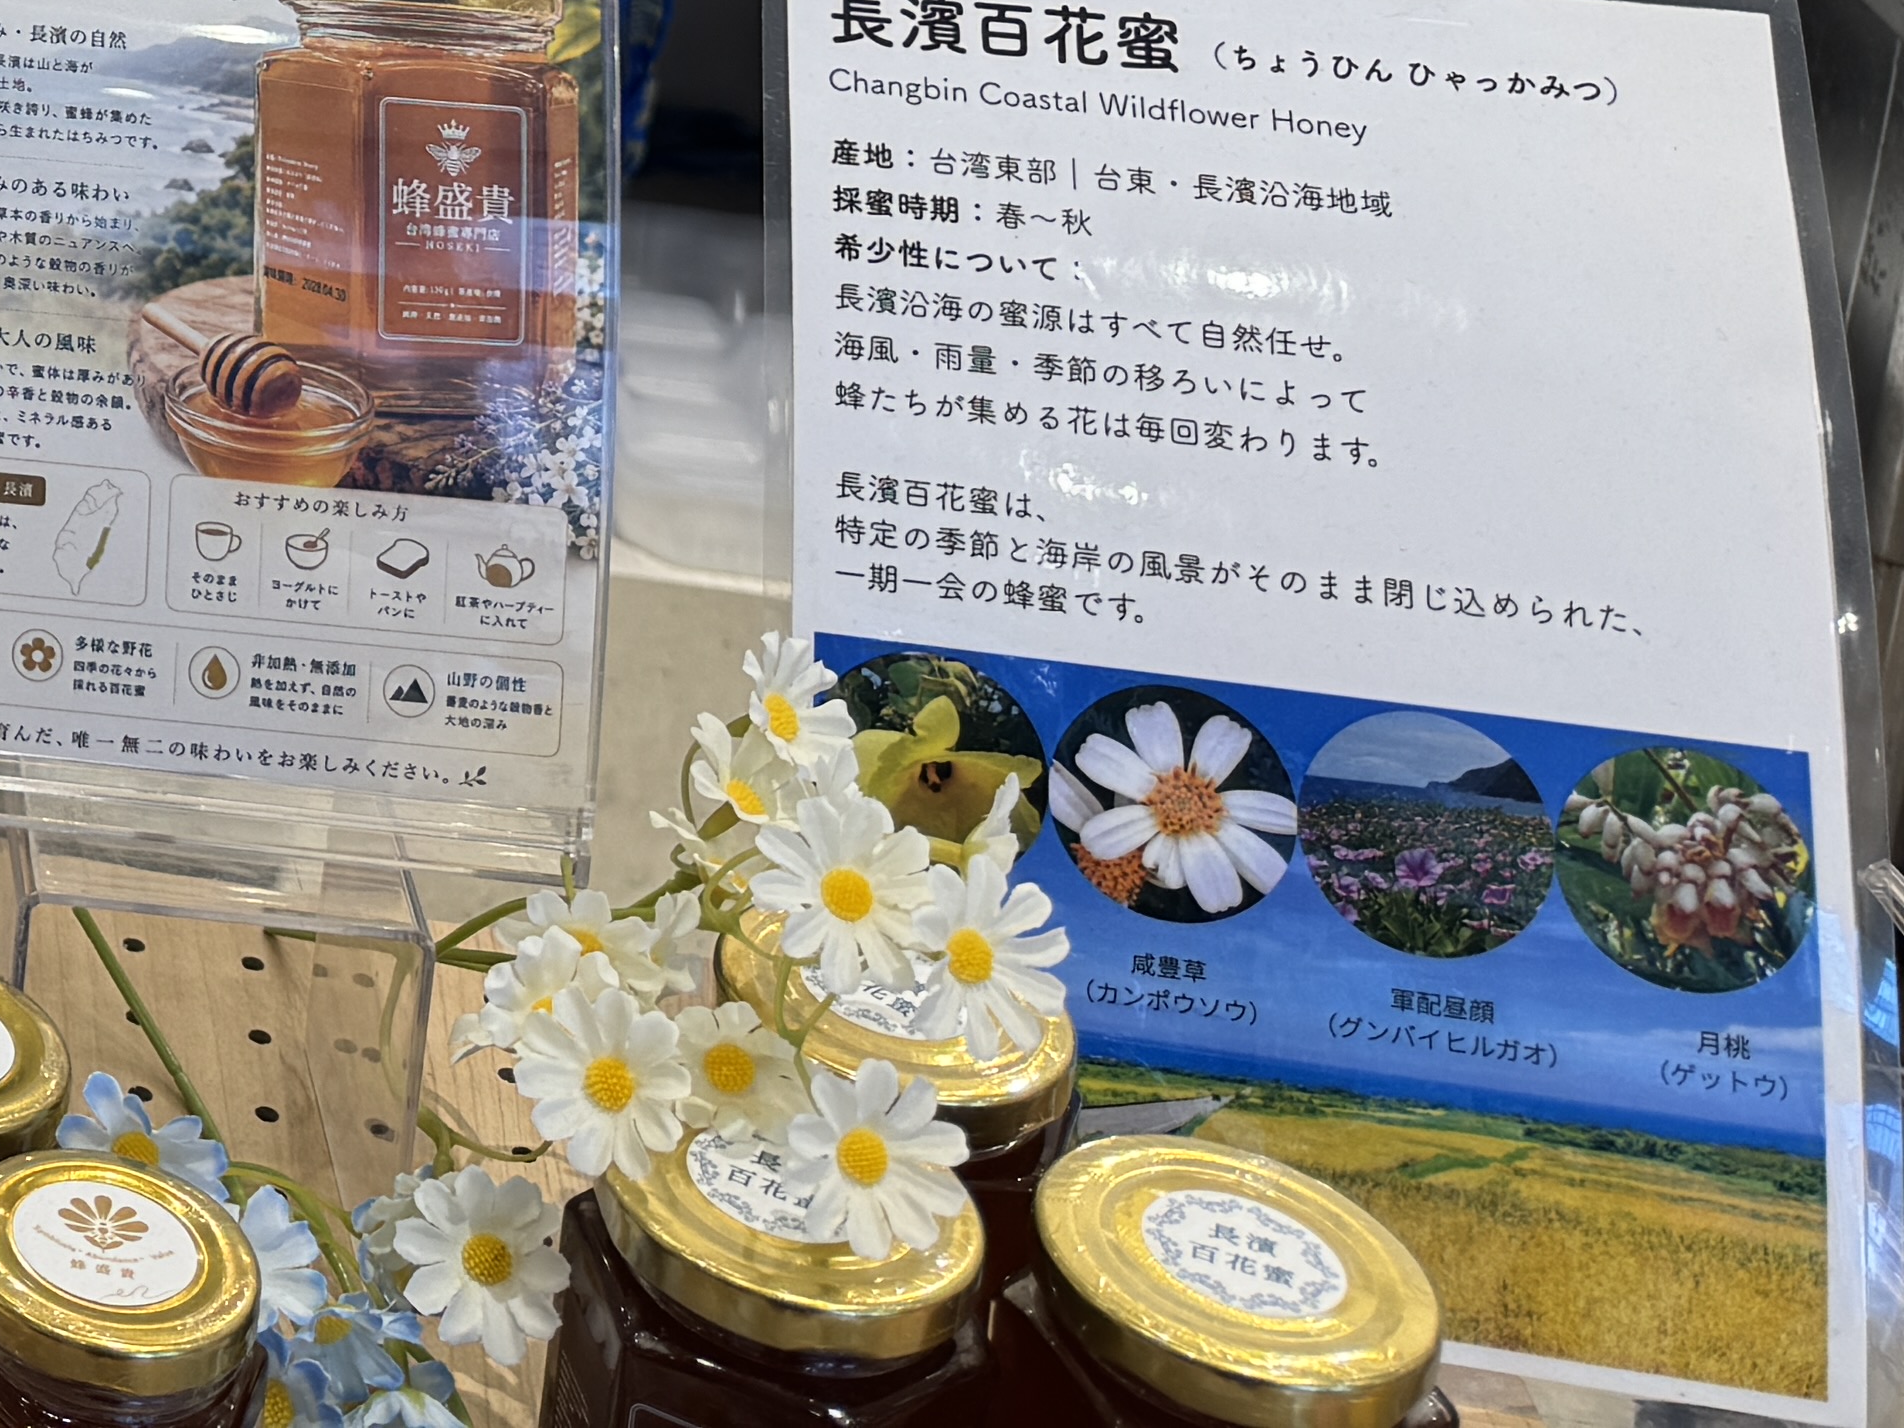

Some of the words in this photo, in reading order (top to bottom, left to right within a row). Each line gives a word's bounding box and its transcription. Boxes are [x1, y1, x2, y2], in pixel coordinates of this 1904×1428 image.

[829, 68, 968, 105] Changbin
[979, 81, 1088, 114] Coastal
[1100, 91, 1260, 129] Wildflower
[1271, 107, 1368, 146] Honey
[392, 178, 515, 224] 蜂盛貴
[834, 332, 1368, 415] 海風・雨量・季節の移ろいによって
[834, 380, 1382, 470] 蜂たちが集める花は毎回変わります。
[234, 491, 409, 522] おすすめの楽しみ方
[836, 471, 1049, 521] 長濱百花蜜は、
[834, 514, 1646, 638] 特定の季節と海岸の風景がそのまま閉じ込められた、
[834, 560, 1146, 625] 一期一会の蜂蜜です。
[1389, 987, 1495, 1027] 軍配昼顔
[1696, 1028, 1753, 1060] 月桃
[1190, 1242, 1295, 1289] 百花蜜
